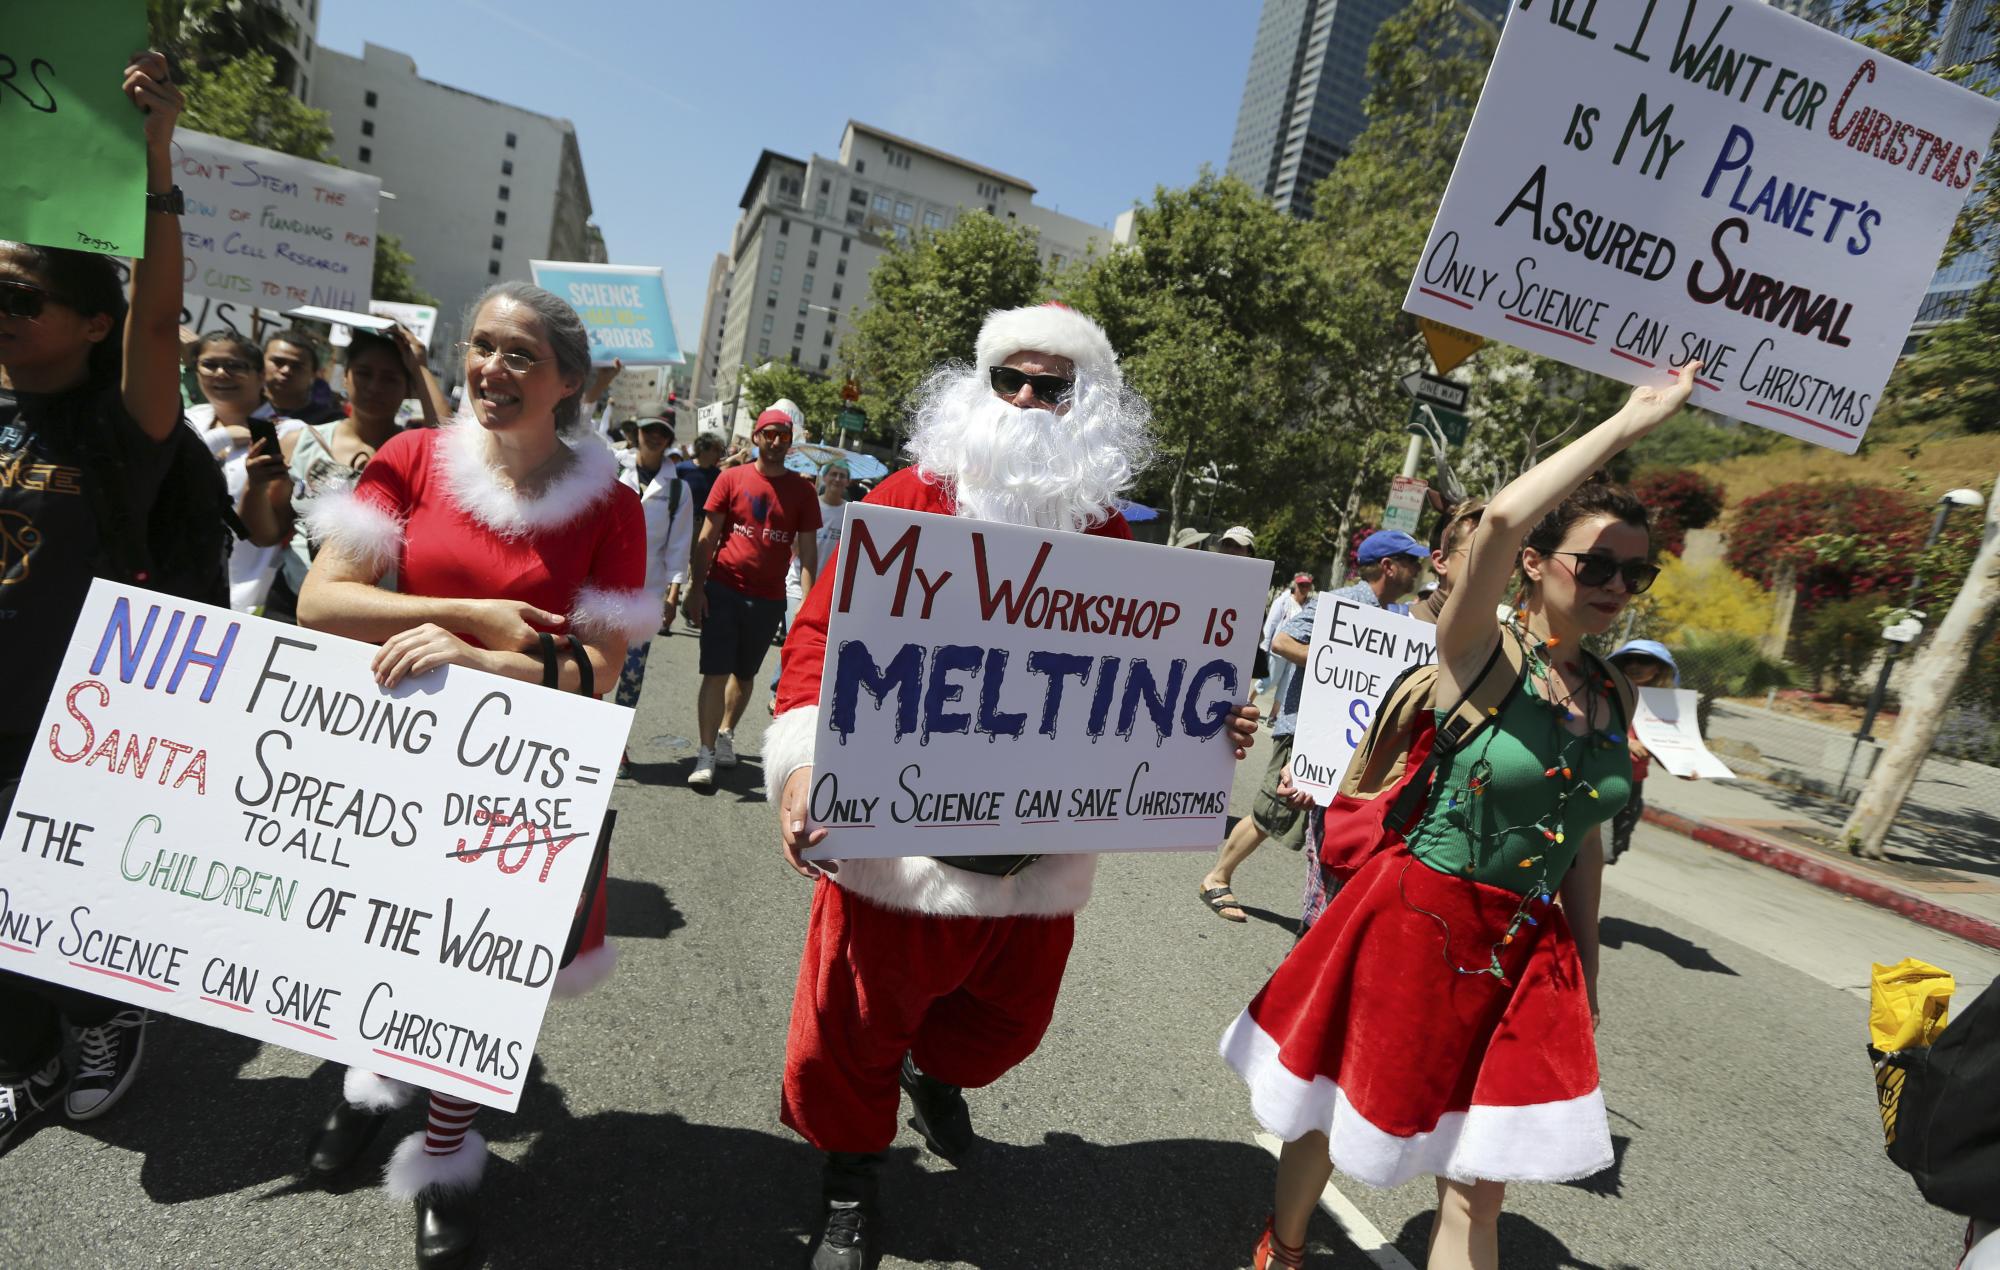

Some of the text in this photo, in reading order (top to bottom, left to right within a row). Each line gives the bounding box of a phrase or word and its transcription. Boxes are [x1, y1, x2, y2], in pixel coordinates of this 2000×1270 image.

[1519, 0, 1979, 190] LL I WANT FOR CHRISTMAS
[231, 160, 298, 197] STEM
[313, 187, 346, 206] THE
[1563, 93, 1881, 255] IS MY PLANET'S
[182, 231, 348, 275] EM CELL RESEARCH
[229, 209, 251, 222] OF
[260, 205, 333, 241] FUNDING
[345, 231, 369, 247] FOR
[1495, 164, 1853, 348] ASSURED SURVIVAL
[203, 267, 252, 292] CUTS
[261, 280, 281, 296] TO
[285, 285, 308, 301] THE
[309, 285, 356, 310] NIH
[568, 282, 644, 308] SCIENCE
[589, 326, 655, 349] RDERS
[1424, 231, 1872, 427] ONLY SCIENCE CAN SAVE CHRISTMAS
[1419, 380, 1462, 402] ONE WAY
[762, 528, 789, 543] FREE
[838, 518, 1237, 647] MY WORKSHOP IS
[1329, 600, 1436, 665] EVEN MY
[89, 596, 241, 703] NIH
[246, 636, 437, 754] FUNDING
[457, 691, 571, 789] CUTS
[828, 640, 1238, 747] MELTING
[1314, 645, 1381, 699] GUIDE
[49, 680, 572, 847] SANTA SPREADS DISEASE
[810, 761, 1225, 824] ONLY SCIENCE CAN SAVE CHRISTMAS
[1293, 753, 1337, 786] ONLY
[242, 811, 350, 868] TO ALL
[457, 810, 578, 883] JOY
[16, 811, 555, 989] THE CHILDREN OF THE WORLD
[0, 888, 523, 1080] ONLY SCIENCE CAN SAVE CHRISTMAS
